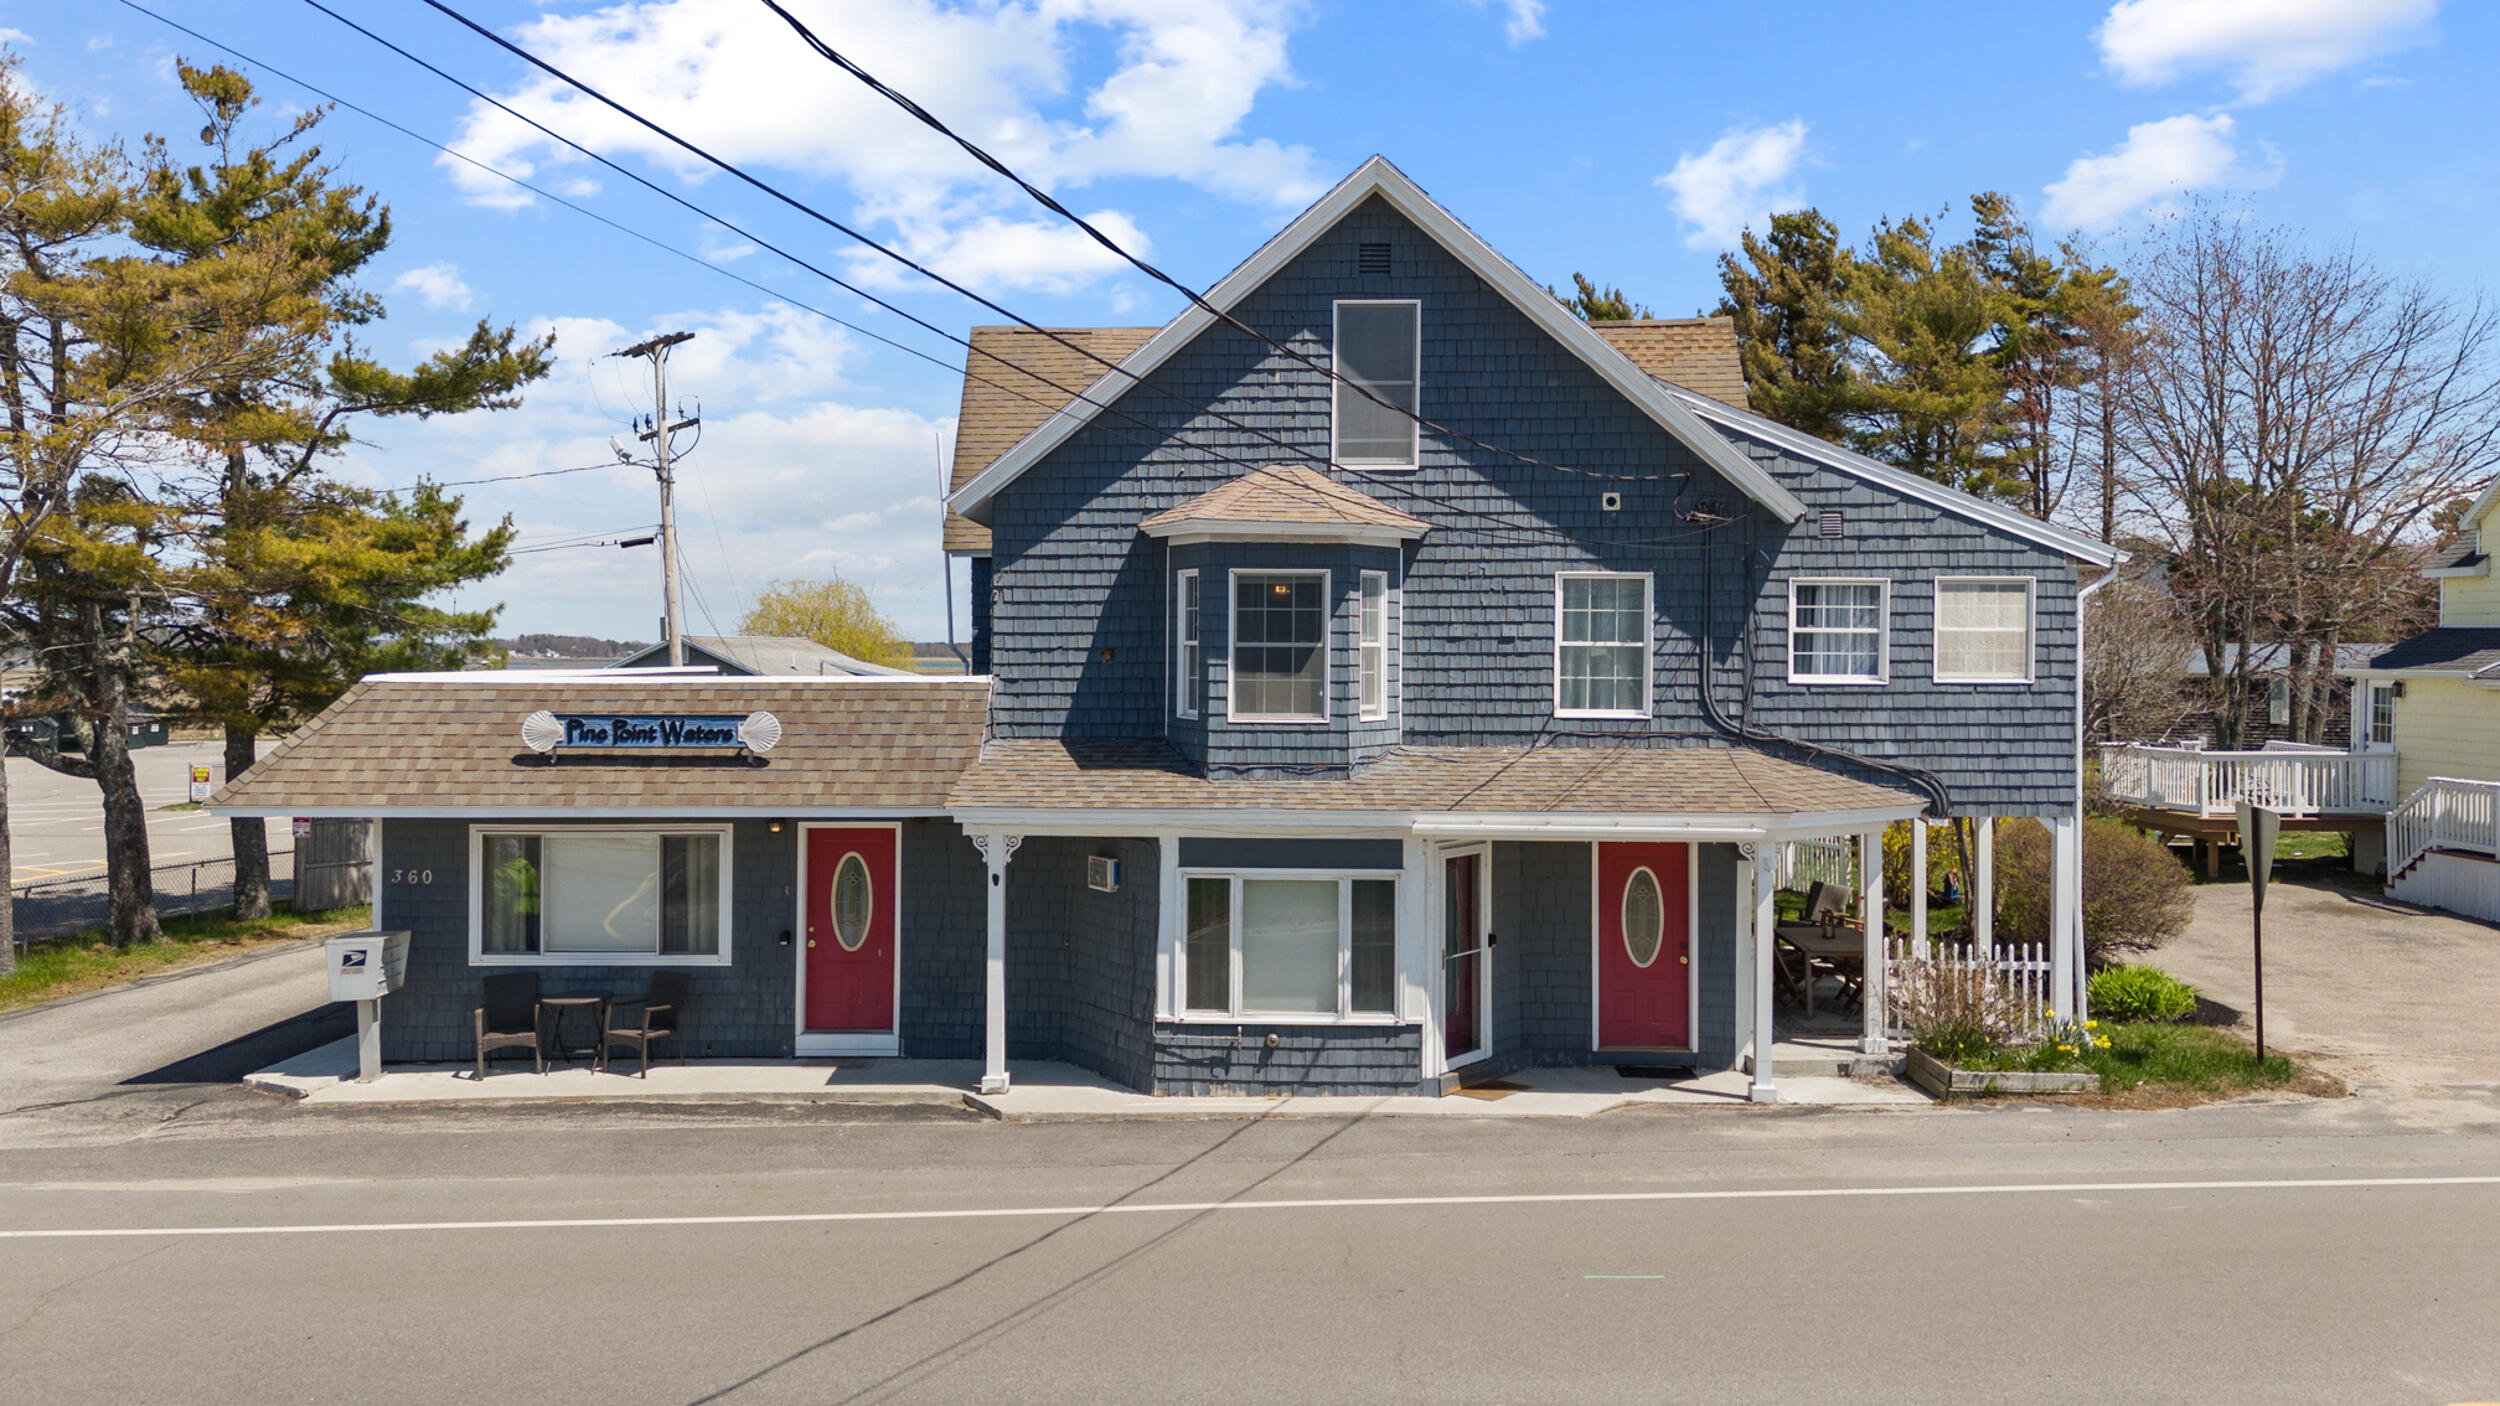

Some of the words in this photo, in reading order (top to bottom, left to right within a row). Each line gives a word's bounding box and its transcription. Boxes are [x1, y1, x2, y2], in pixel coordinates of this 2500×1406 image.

[567, 718, 608, 745] Pine
[612, 718, 657, 745] Point
[659, 719, 734, 746] Waters
[391, 869, 433, 885] 360
